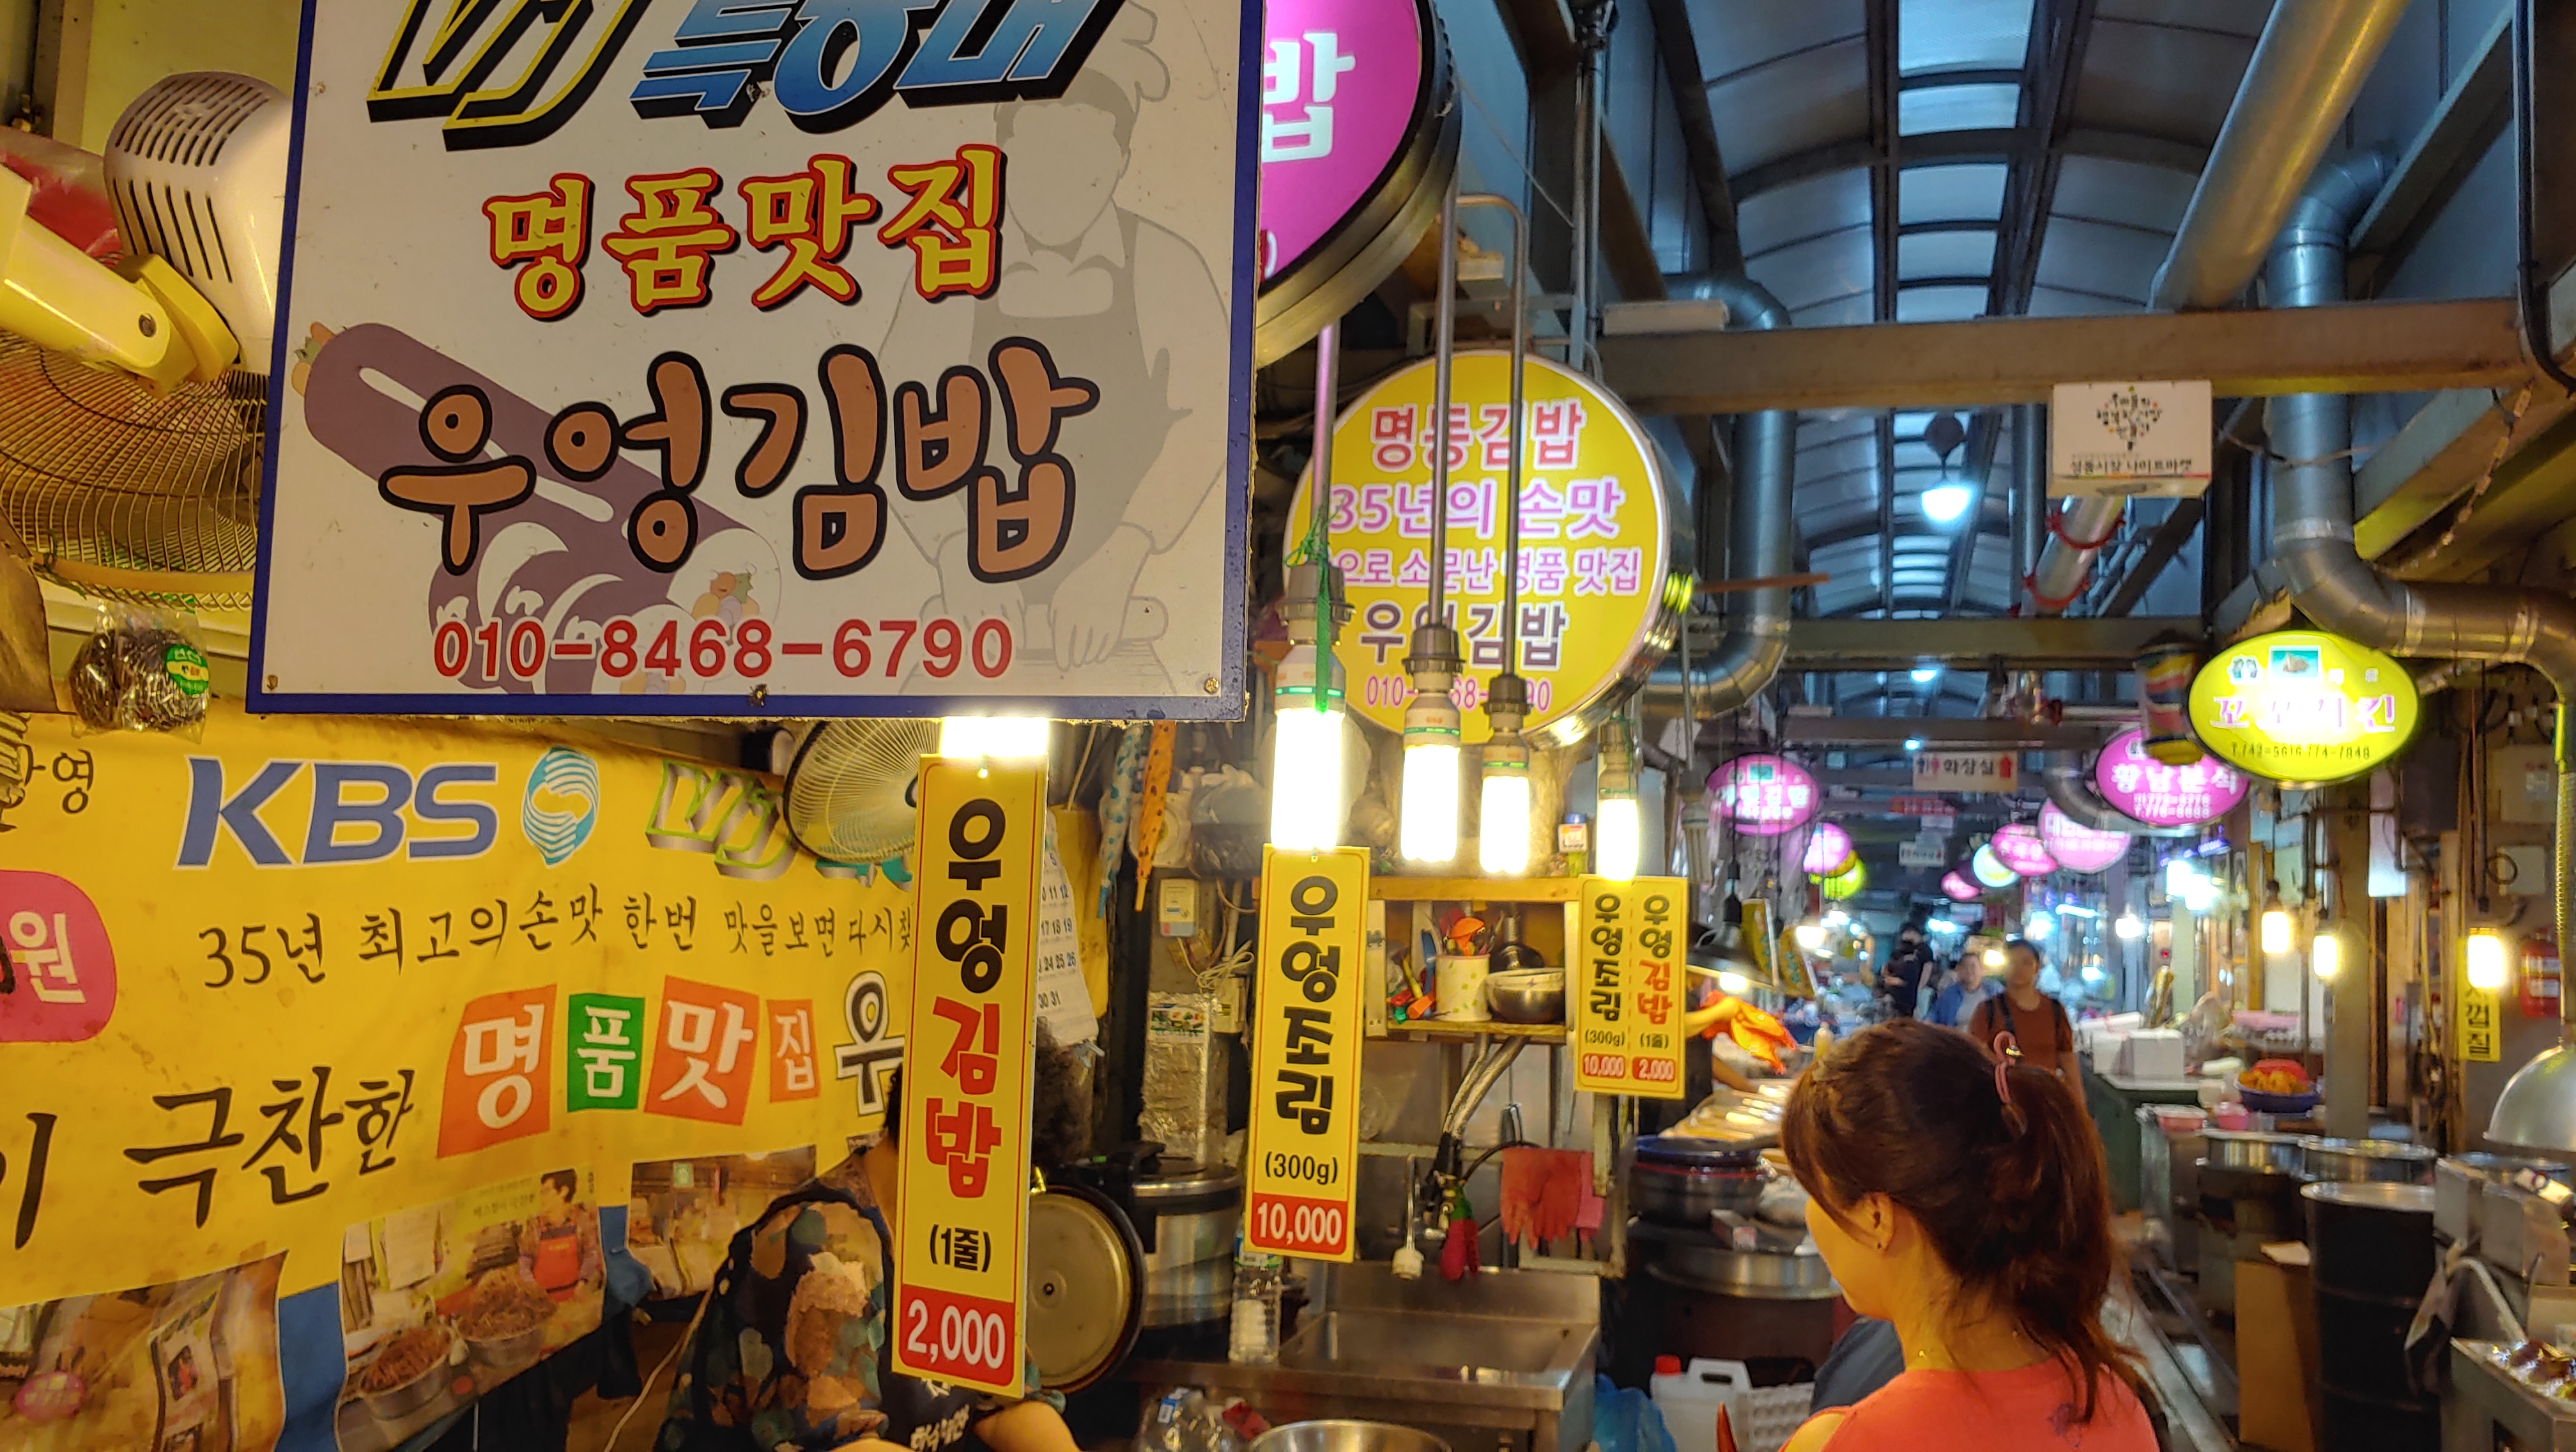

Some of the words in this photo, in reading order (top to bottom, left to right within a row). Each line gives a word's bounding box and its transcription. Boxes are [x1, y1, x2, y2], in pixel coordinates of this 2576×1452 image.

[483, 144, 1008, 320] 명품맛집
[378, 336, 1100, 583] 우엉김밥
[1330, 481, 1492, 538] 35년의
[1515, 481, 1623, 536] 손맛
[1577, 552, 1641, 593] 맛집
[433, 619, 1014, 680] 010-8468-6790
[1365, 675, 1552, 713] 010-68-90
[174, 755, 500, 870] KBS
[198, 913, 326, 989] 35년
[622, 893, 697, 952] 한번
[1590, 893, 1623, 1022] 우엉조림
[1637, 895, 1673, 1025] 우엉김밥
[924, 798, 1008, 1198] 우엉김밥
[1275, 876, 1339, 1135] 우엉조림
[1584, 1028, 1625, 1047] (300g)
[123, 1066, 415, 1230] 극찬한
[1265, 1152, 1338, 1186] (300g)
[929, 1224, 992, 1273] (1줄)
[1257, 1201, 1342, 1246] 10,000
[907, 1299, 1006, 1370] 2,000
